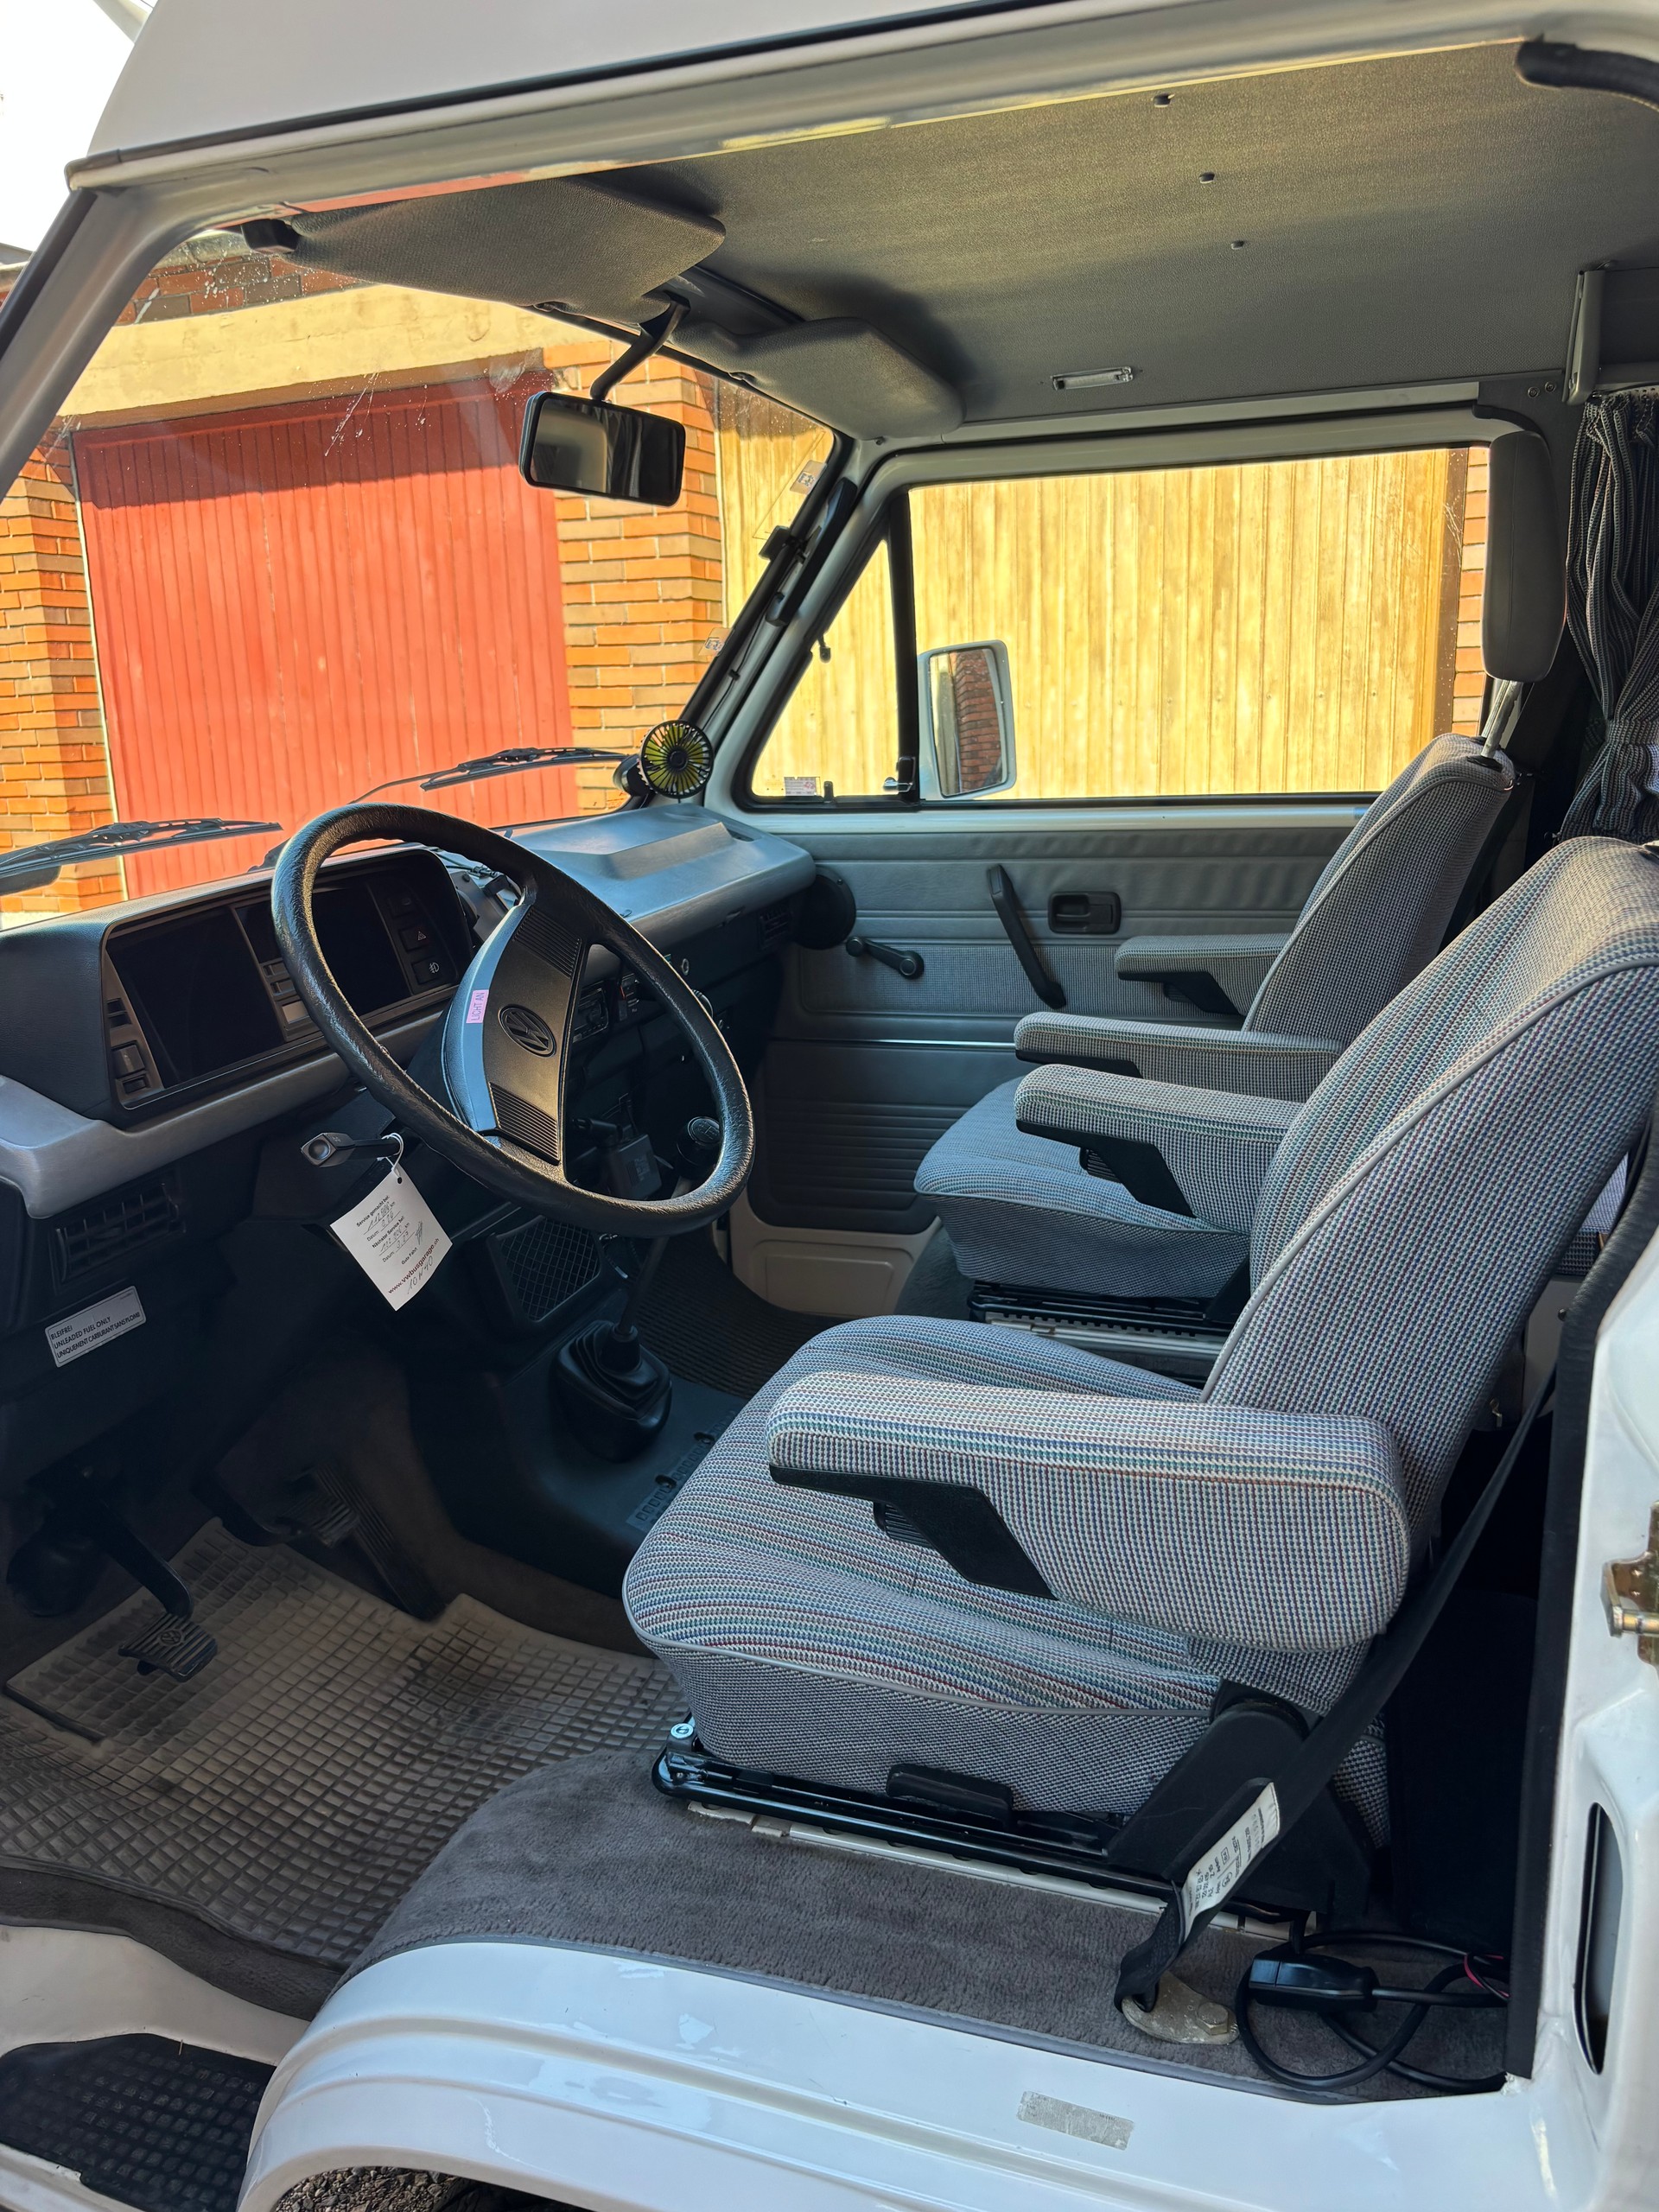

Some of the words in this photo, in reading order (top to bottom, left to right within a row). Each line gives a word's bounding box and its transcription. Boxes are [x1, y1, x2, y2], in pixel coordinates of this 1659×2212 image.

[475, 992, 485, 1001] AN
[471, 1002, 482, 1020] LICHT
[356, 1214, 371, 1227] Service
[369, 1200, 385, 1217] gemacht
[386, 1222, 400, 1235] Service
[388, 1238, 440, 1294] www.vwbusgarage.ch
[49, 1325, 73, 1340] BLEIFREI
[52, 1330, 83, 1350] UNLEADED
[82, 1324, 98, 1335] FUEL
[96, 1316, 111, 1329] ONLY
[55, 1338, 88, 1358] UNIQUEMENT
[87, 1324, 116, 1343] CARBURANT
[113, 1319, 126, 1330] SANS
